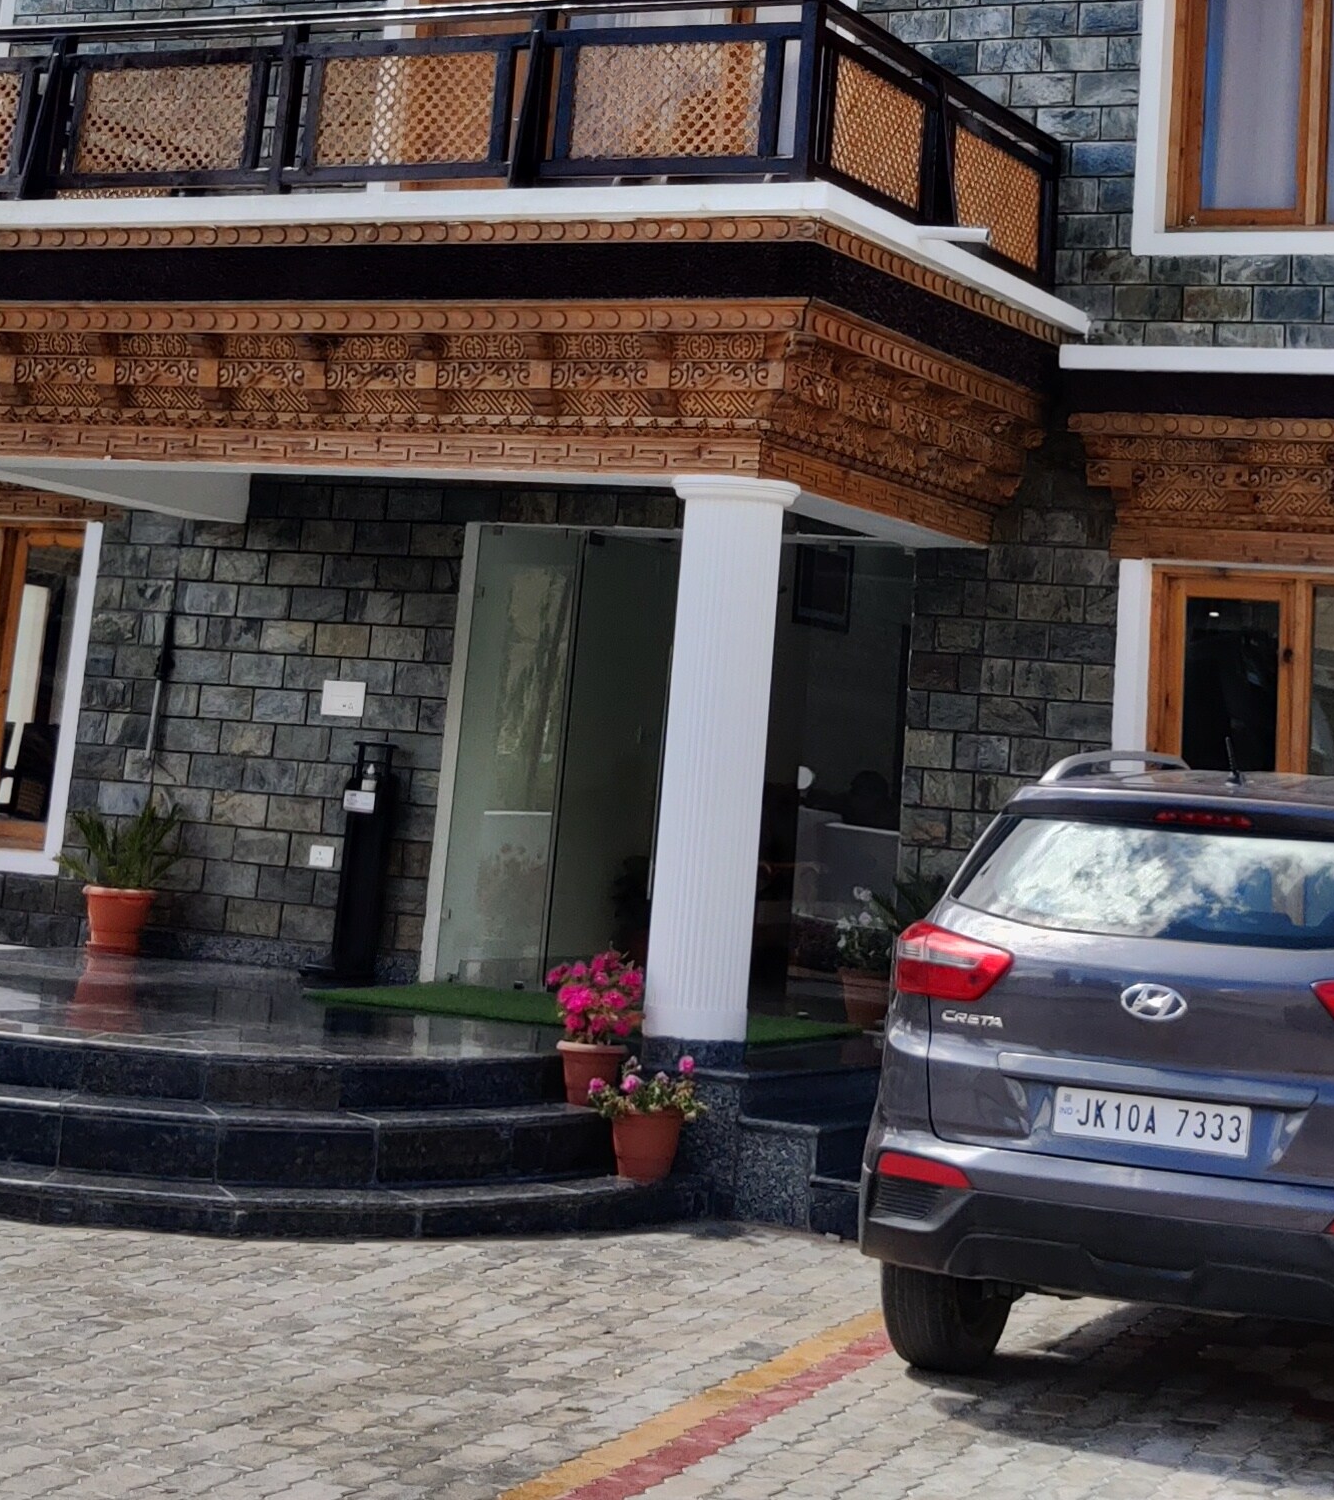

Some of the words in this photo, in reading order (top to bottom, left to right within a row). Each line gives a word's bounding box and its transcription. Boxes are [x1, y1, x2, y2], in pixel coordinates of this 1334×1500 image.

[941, 1009, 1003, 1028] CRETA
[1077, 1098, 1157, 1135] JK10A
[1176, 1108, 1242, 1143] 7333
